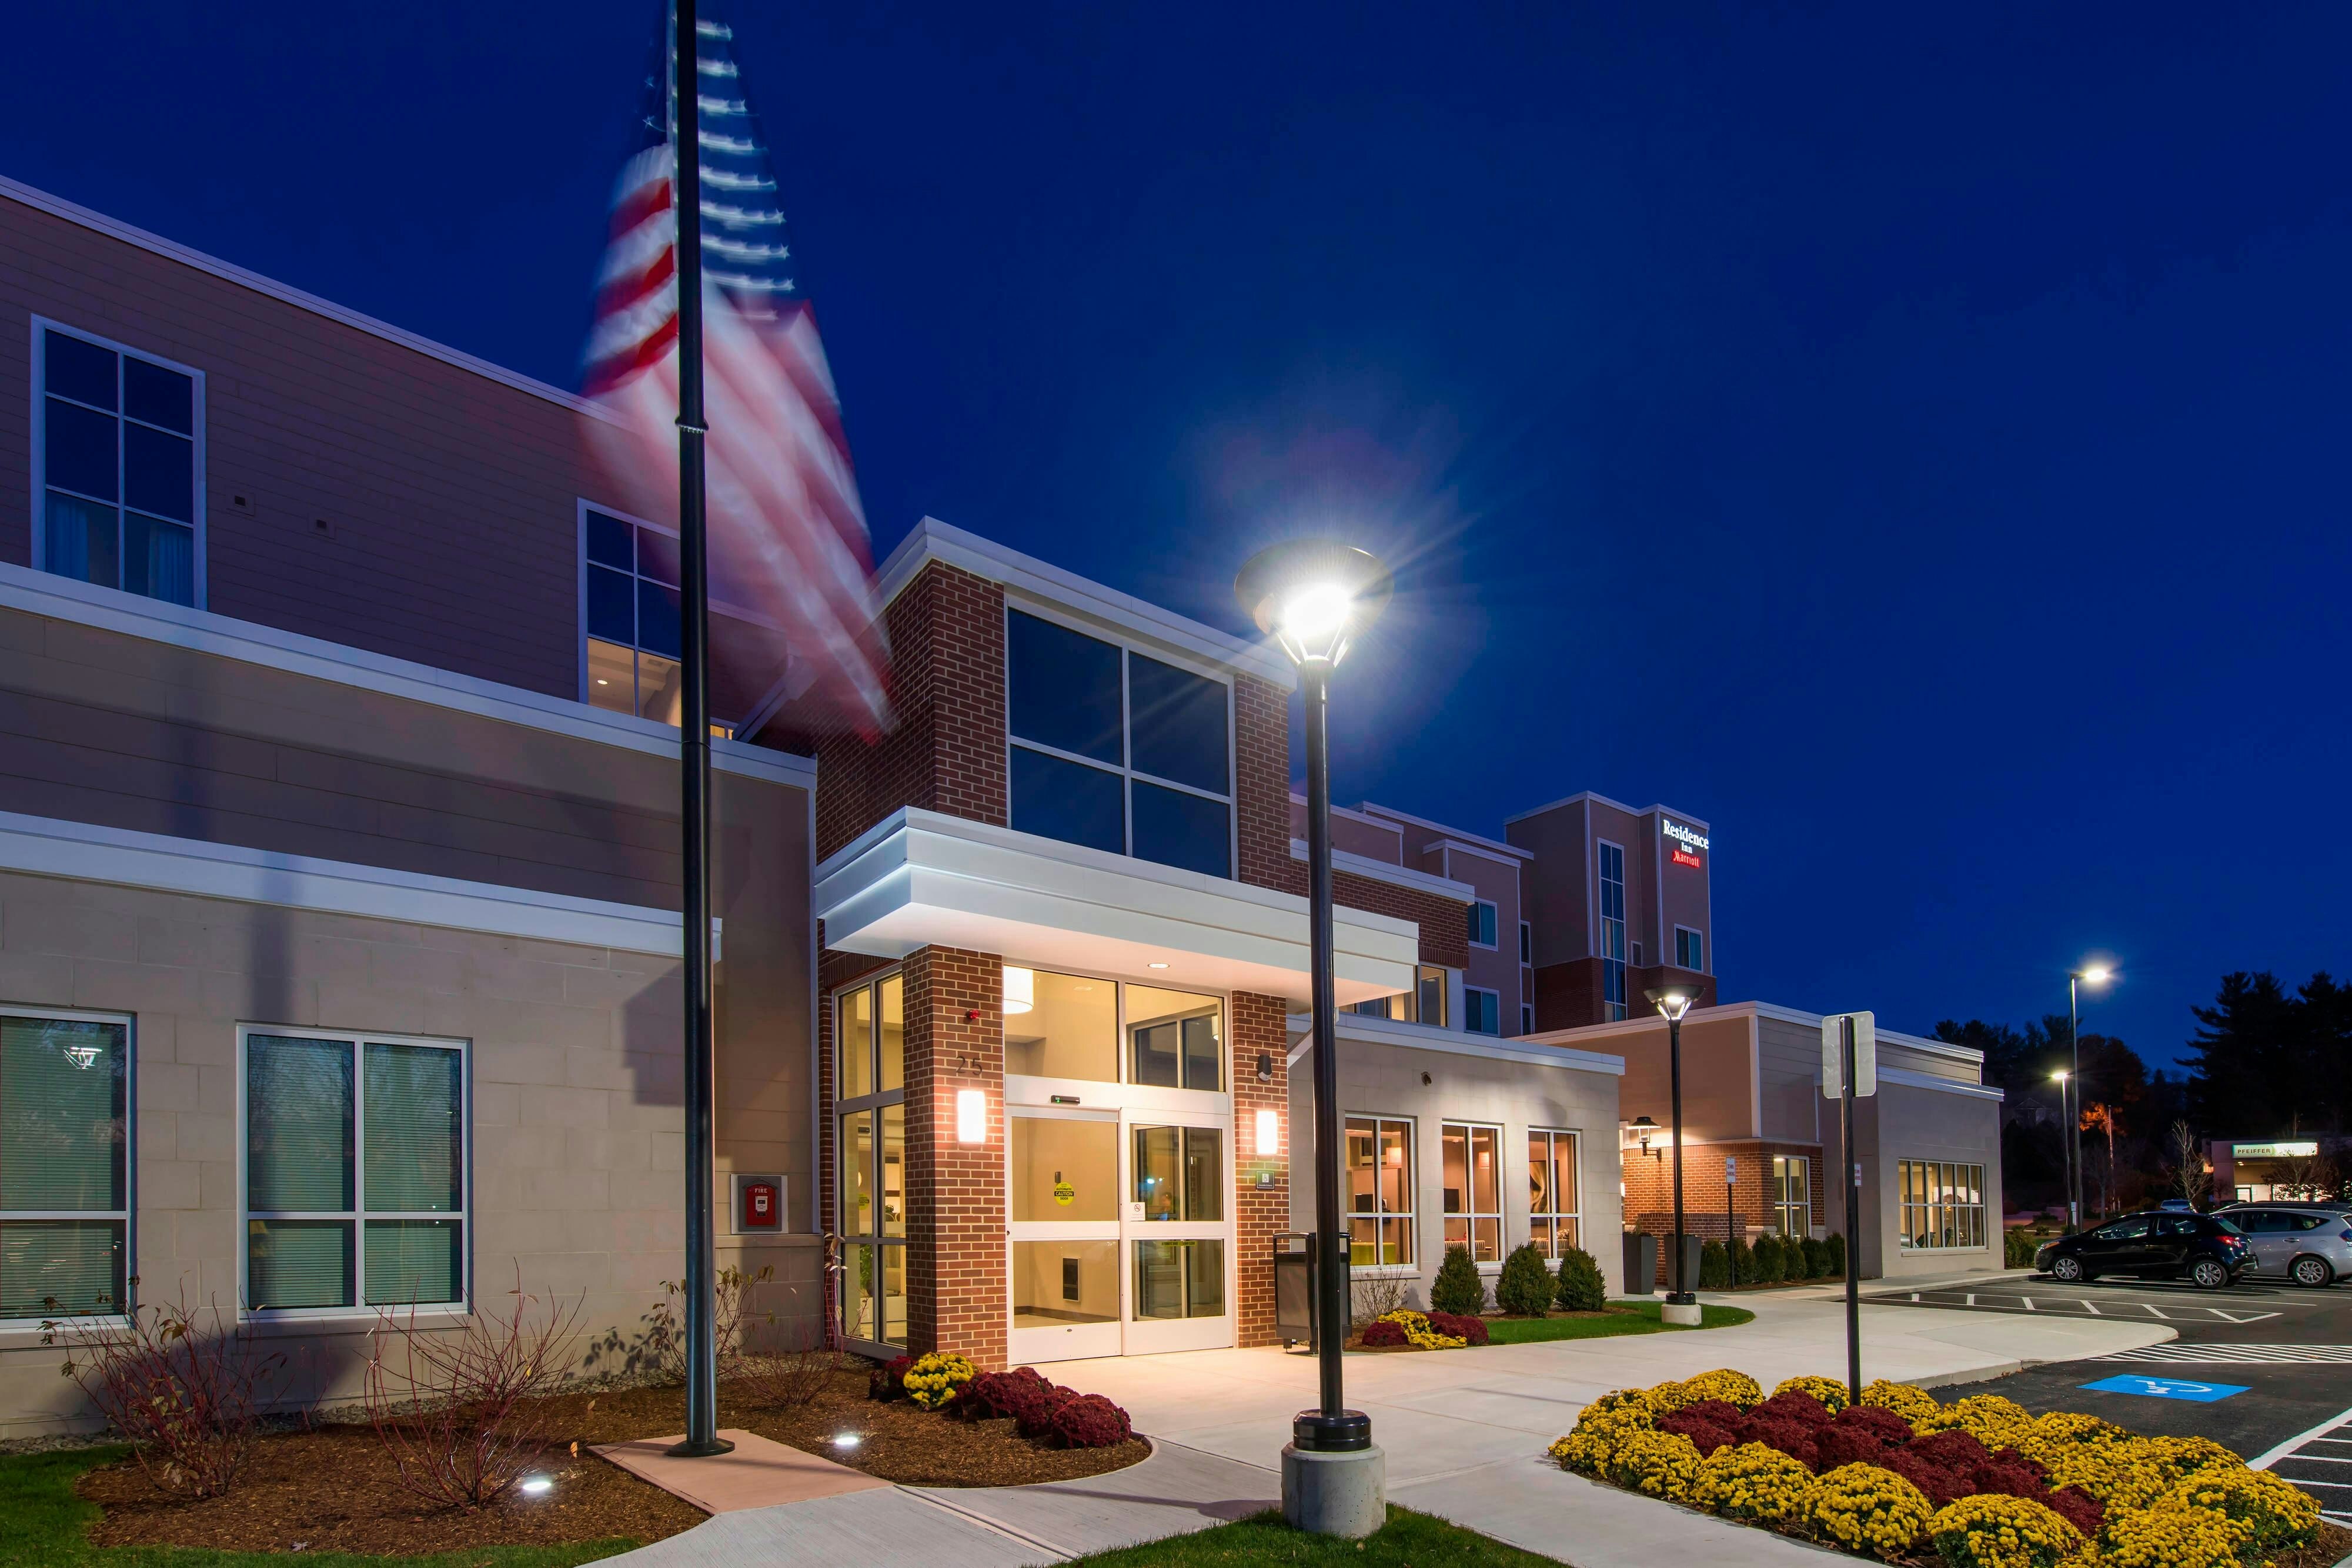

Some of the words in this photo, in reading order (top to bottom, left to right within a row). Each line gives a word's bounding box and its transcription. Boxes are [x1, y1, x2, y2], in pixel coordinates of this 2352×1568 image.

[1663, 820, 1709, 849] Residence
[1681, 842, 1692, 854] Inn
[1673, 851, 1699, 867] Marriott
[956, 1056, 983, 1075] 25
